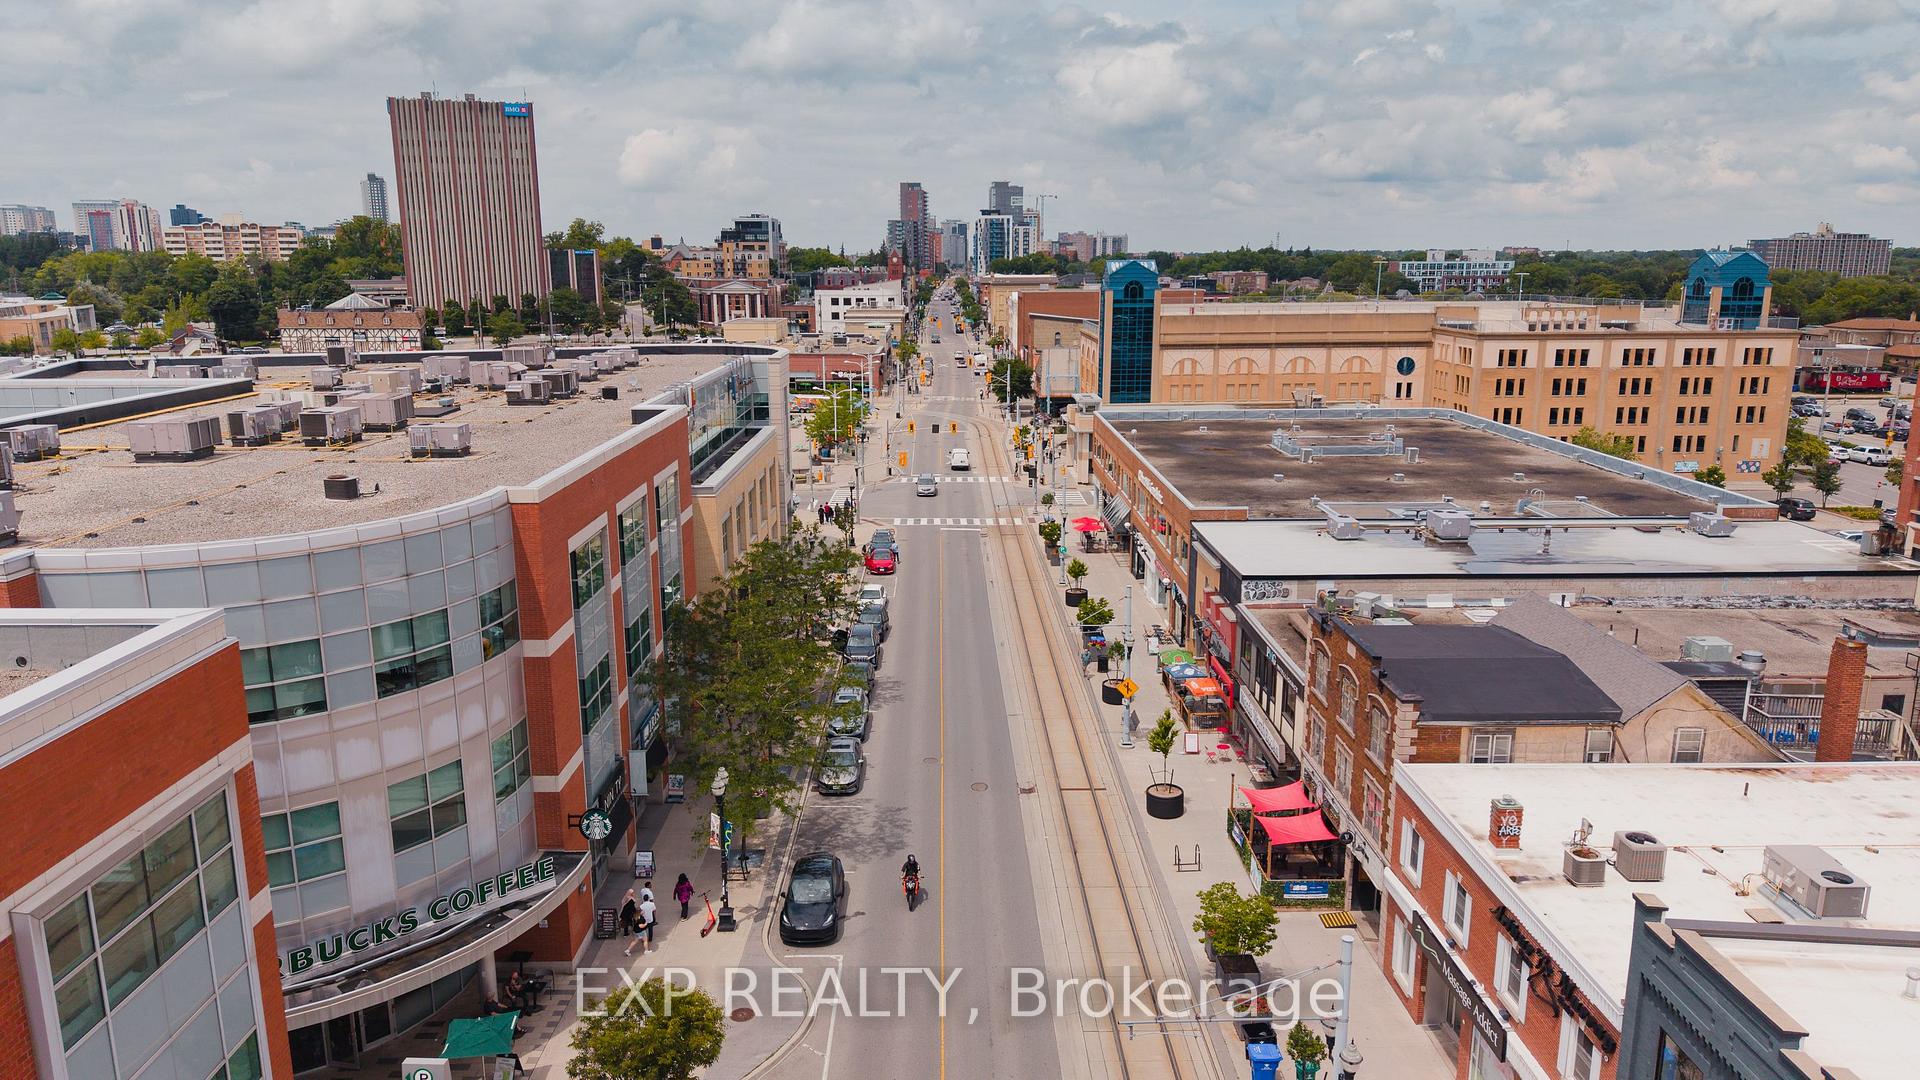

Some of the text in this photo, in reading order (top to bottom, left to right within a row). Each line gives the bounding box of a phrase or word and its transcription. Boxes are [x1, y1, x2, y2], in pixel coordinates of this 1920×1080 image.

[428, 856, 556, 922] COFFEE
[1442, 960, 1499, 1048] Massage Addict
